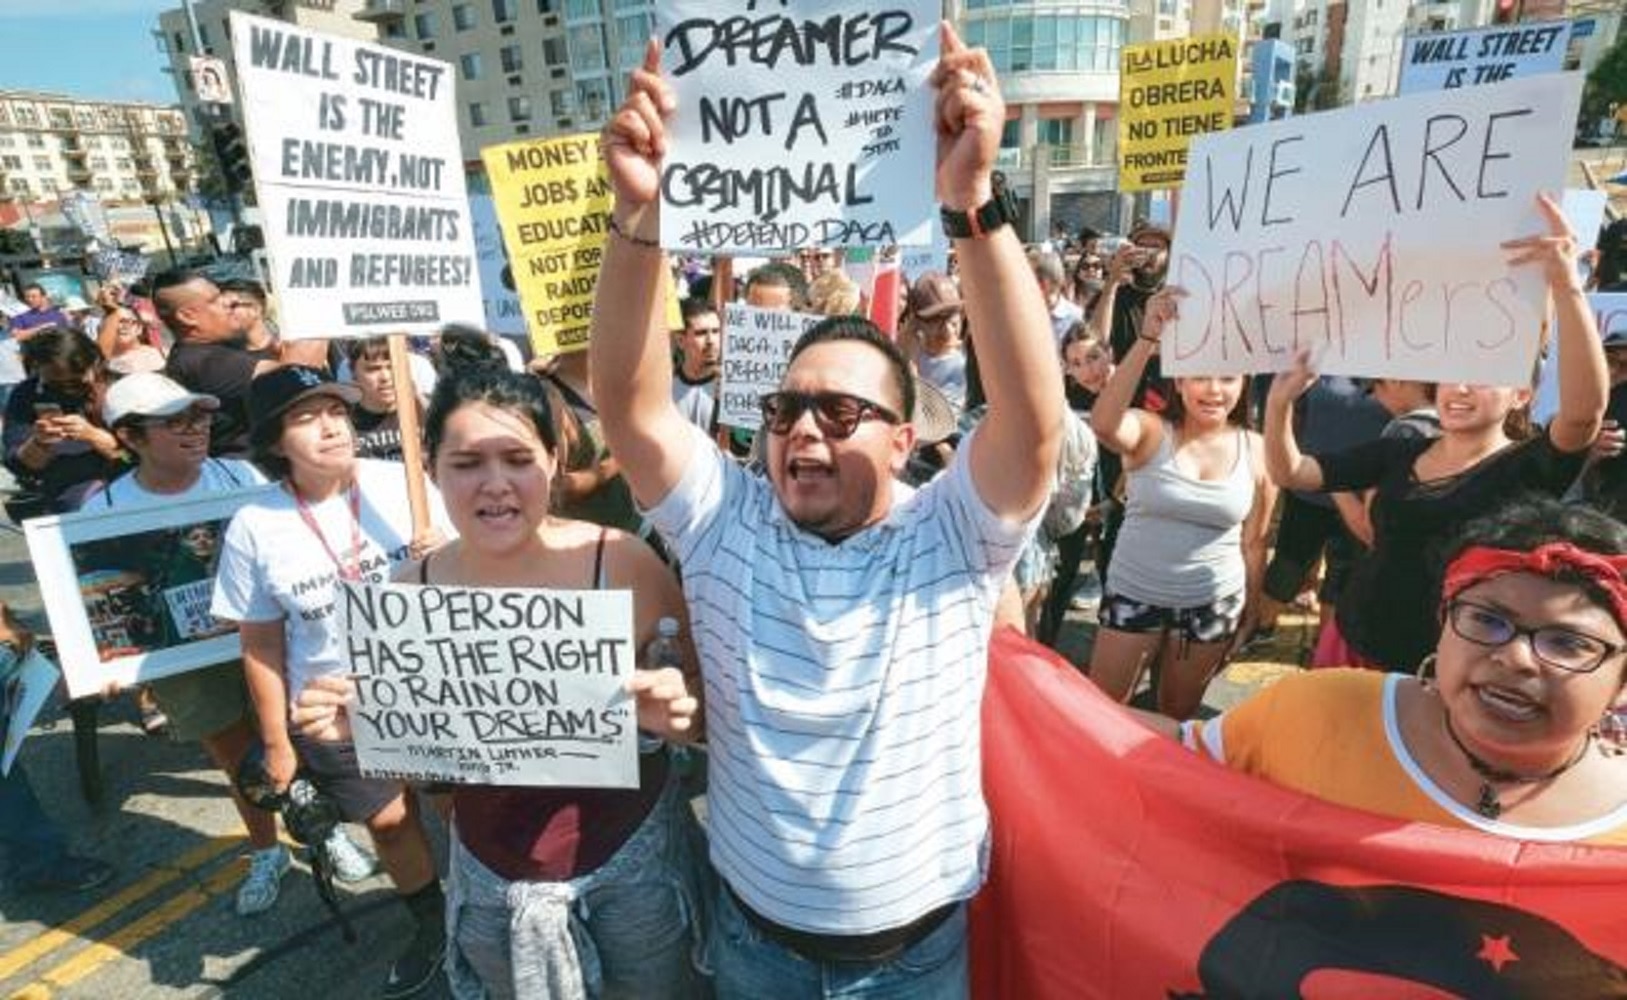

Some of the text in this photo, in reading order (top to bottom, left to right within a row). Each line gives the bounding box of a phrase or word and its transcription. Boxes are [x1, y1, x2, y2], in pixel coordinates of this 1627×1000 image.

[665, 10, 919, 77] DREAMER
[1157, 38, 1233, 69] LUCHA
[1411, 26, 1564, 65] WALL STREET
[251, 25, 445, 101] WALL STREET
[1444, 67, 1468, 89] IS
[1130, 77, 1226, 109] OBRERA
[319, 92, 406, 141] IS THE
[699, 92, 828, 150] NOT A
[1129, 112, 1226, 141] NO TIENE
[505, 140, 588, 173] MONEY
[1124, 149, 1188, 170] FRONTE
[1206, 109, 1534, 232] WE ARE
[660, 160, 875, 222] CRIMINAL
[286, 197, 460, 242] IMMIGRANTS
[517, 211, 611, 245] EDUCATI
[680, 218, 897, 249] #DEFEND DACA
[288, 252, 472, 289] AND REFUGEES!
[529, 252, 568, 277] NOT
[1173, 230, 1519, 361] DREAMers
[754, 311, 797, 332] WILL
[344, 583, 585, 634] NO PERSON
[348, 635, 627, 678] HAS THE RIGHT
[347, 674, 559, 707] TO RAIN ON
[358, 709, 458, 741] YOUR
[406, 745, 559, 762] MARTIN LUTHER
